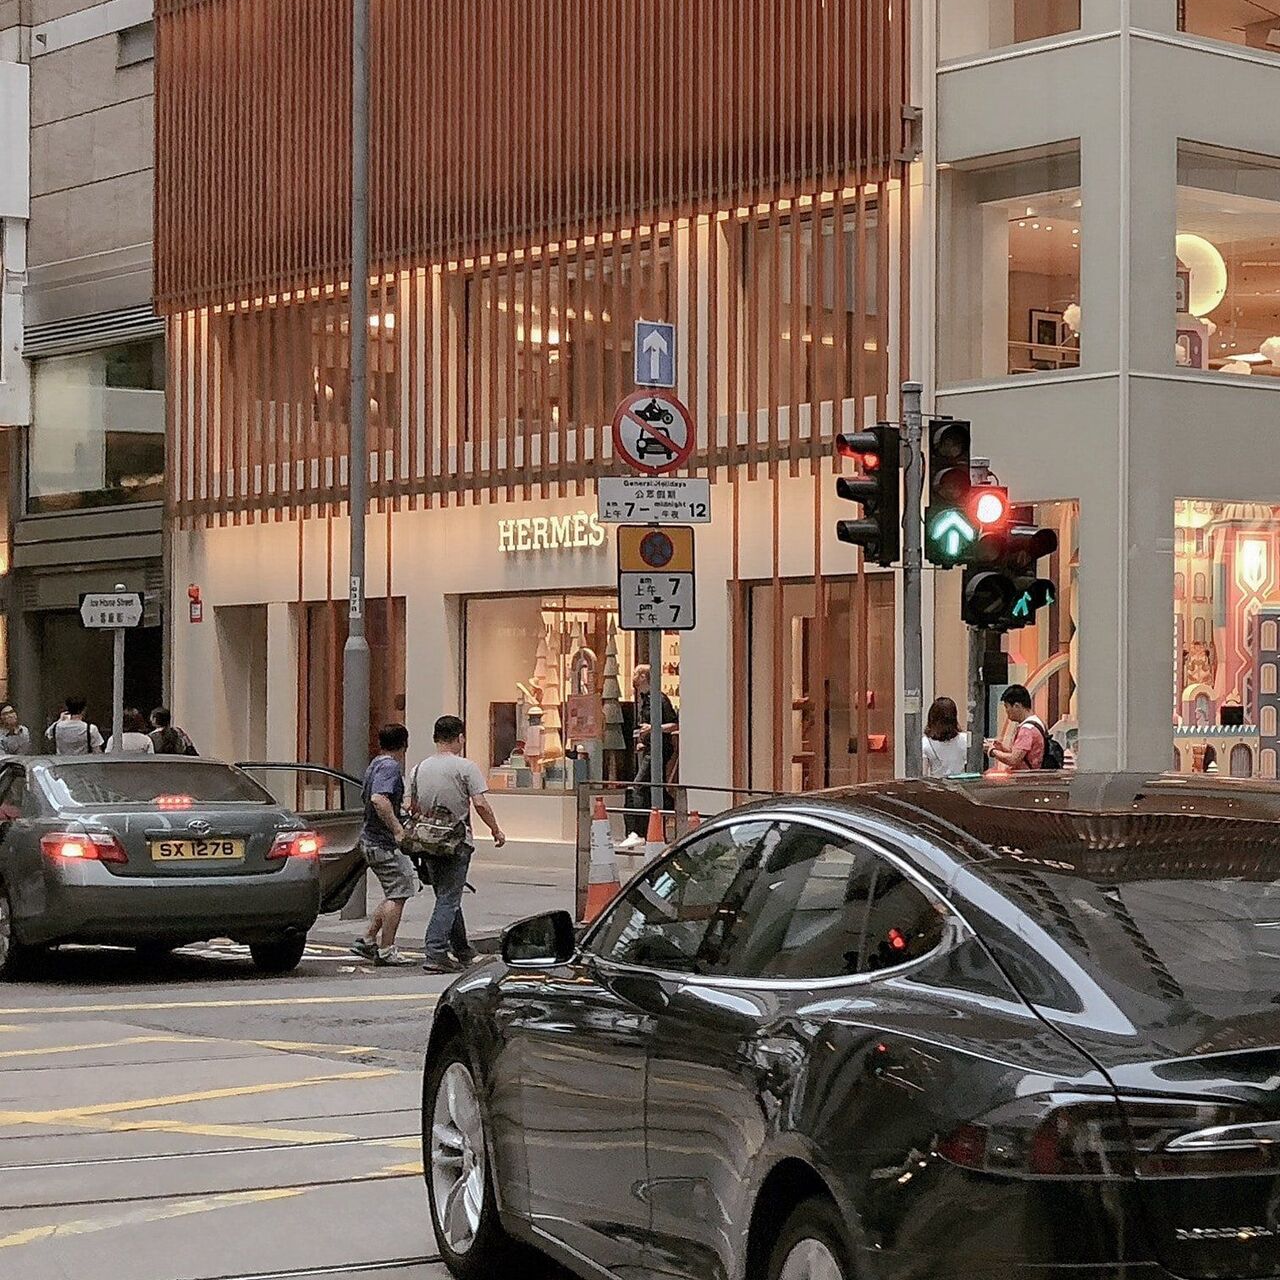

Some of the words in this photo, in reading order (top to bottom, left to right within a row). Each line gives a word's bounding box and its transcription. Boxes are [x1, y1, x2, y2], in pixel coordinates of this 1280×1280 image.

[603, 509, 622, 518] 上午
[624, 502, 636, 517] 7
[688, 502, 707, 518] 12
[498, 510, 605, 552] HERMÈS
[634, 585, 657, 596] 上午
[668, 578, 681, 596] 7
[635, 613, 658, 624] 下午
[639, 603, 653, 611] pm
[669, 605, 682, 623] 7
[160, 843, 185, 857] SX
